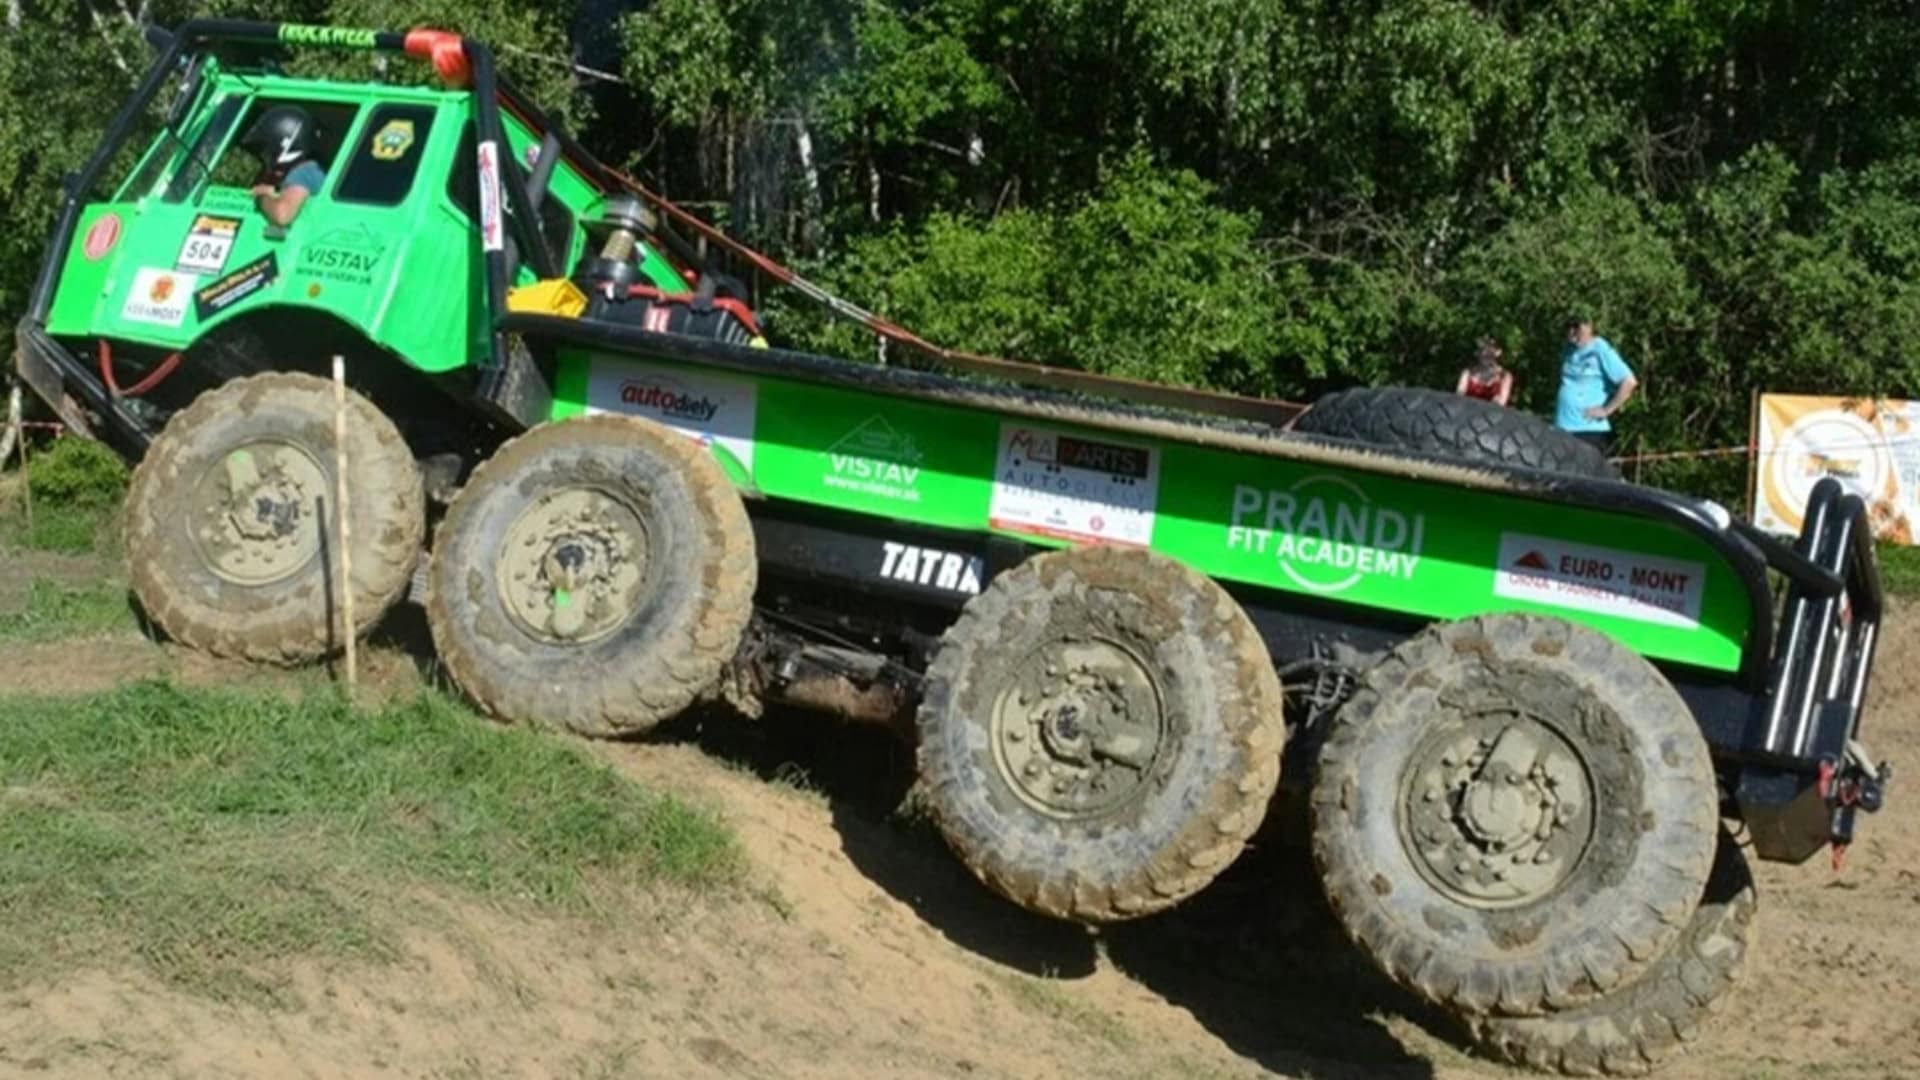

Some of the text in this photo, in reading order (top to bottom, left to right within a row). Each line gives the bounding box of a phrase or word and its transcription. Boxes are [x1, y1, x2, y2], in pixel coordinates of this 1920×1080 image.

[186, 241, 223, 260] 504
[307, 247, 379, 273] VISTAV
[621, 380, 719, 422] autodiely
[830, 453, 920, 485] VISTAV
[1231, 484, 1425, 555] PRANDI
[880, 541, 983, 594] TATRA
[1226, 525, 1420, 580] FIT ACADEMY
[1559, 555, 1613, 580] EURO
[1630, 567, 1690, 592] MONT
